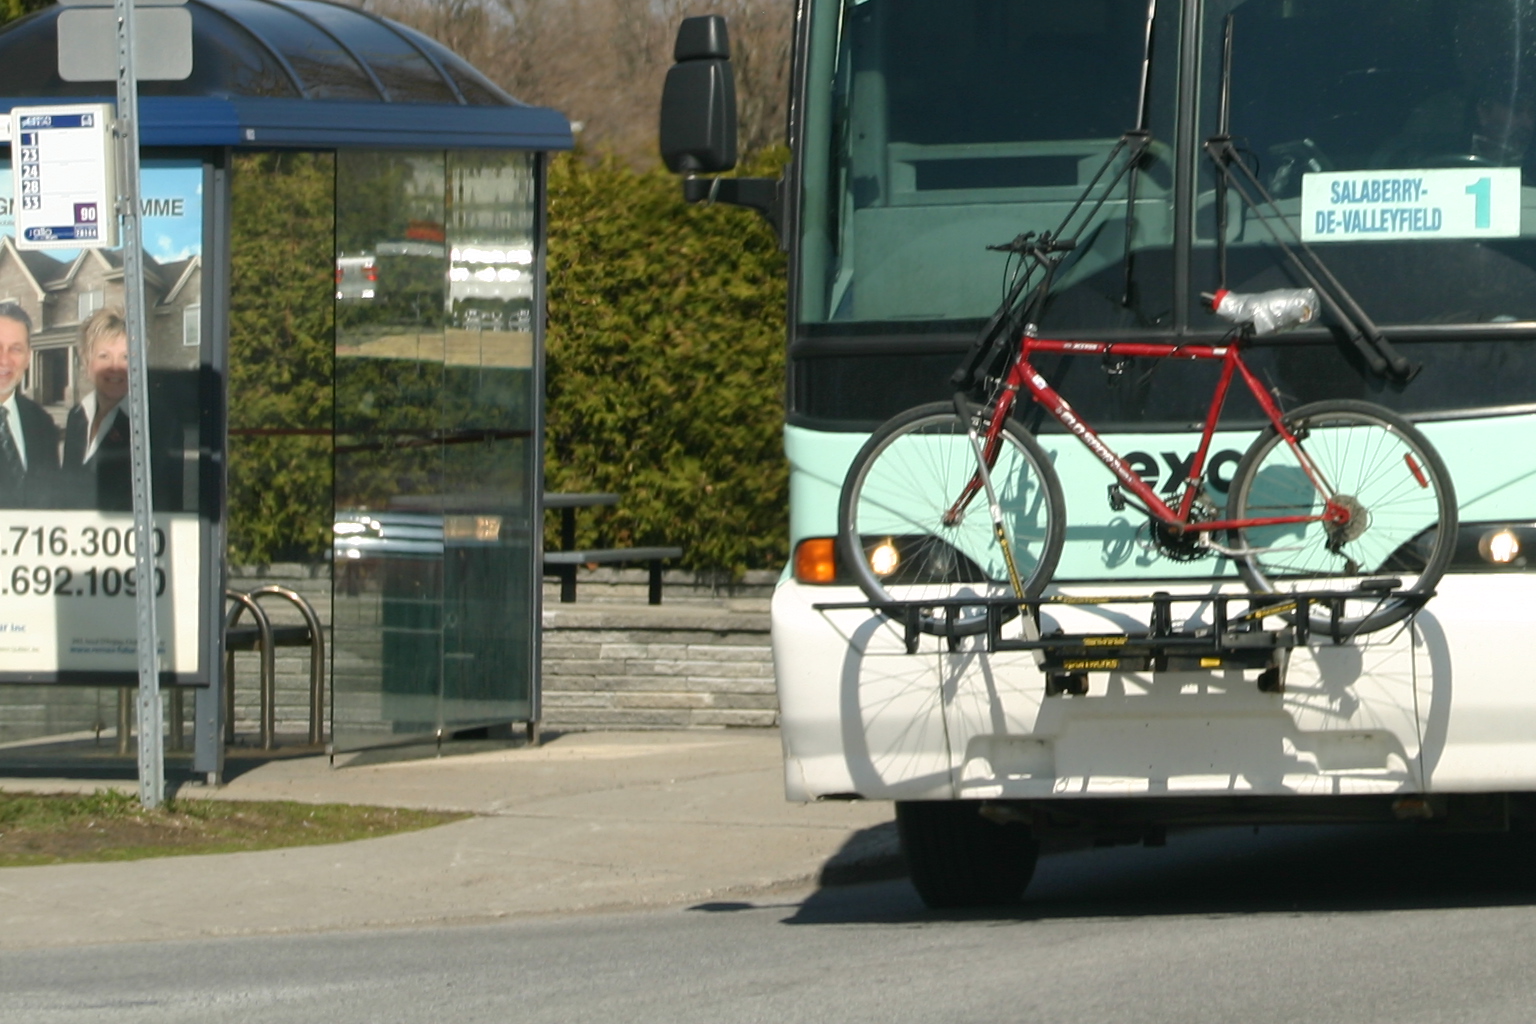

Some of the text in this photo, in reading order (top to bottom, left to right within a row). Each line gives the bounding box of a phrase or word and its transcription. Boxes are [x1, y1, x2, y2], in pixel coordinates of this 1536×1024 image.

[29, 133, 36, 146] 1
[23, 149, 38, 161] 23
[23, 165, 38, 178] 24
[23, 181, 39, 194] 28
[1330, 178, 1428, 205] SALABERRY-
[24, 197, 40, 210] 33
[1464, 176, 1491, 229] 1
[80, 207, 96, 221] 90
[1315, 207, 1443, 235] DE-VALLEYFIELD
[1120, 449, 1244, 494] exo
